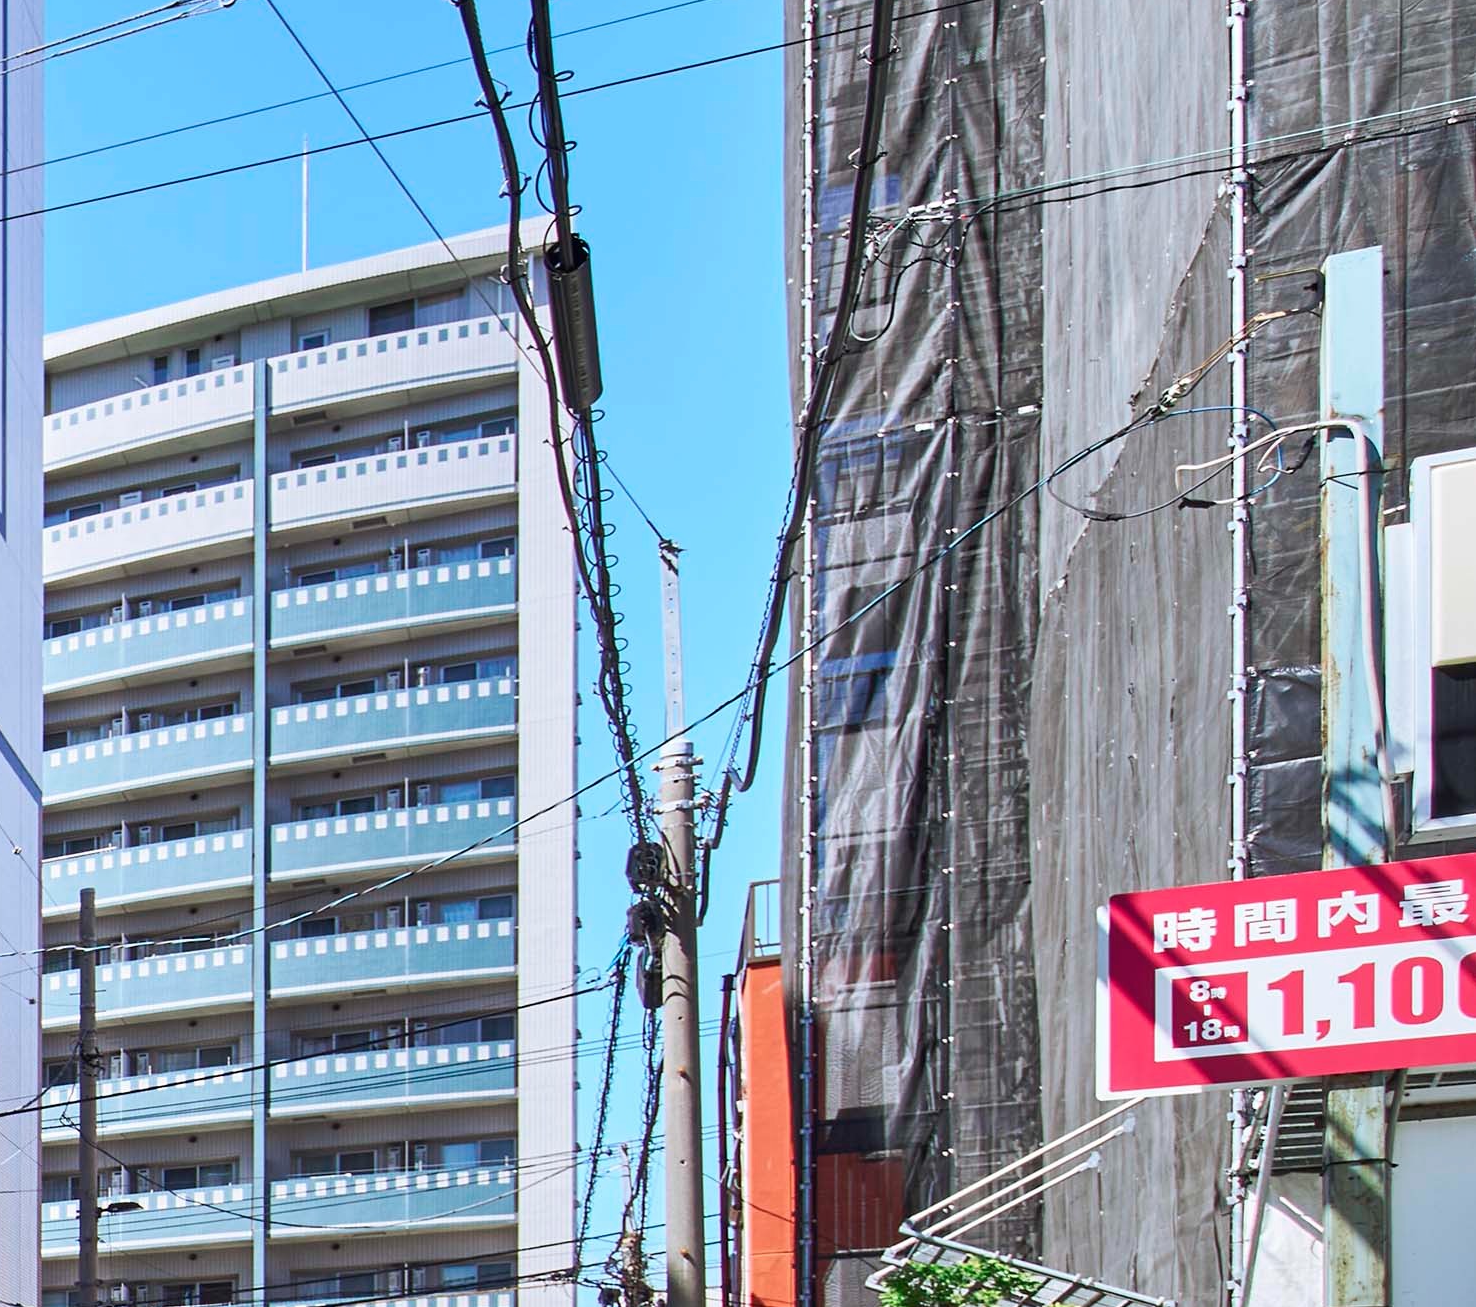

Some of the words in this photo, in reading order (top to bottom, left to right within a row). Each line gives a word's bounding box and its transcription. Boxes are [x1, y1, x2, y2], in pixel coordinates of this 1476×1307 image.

[1153, 879, 1469, 953] 時間内最
[1189, 980, 1227, 1003] 8時
[1183, 1018, 1240, 1041] 18時
